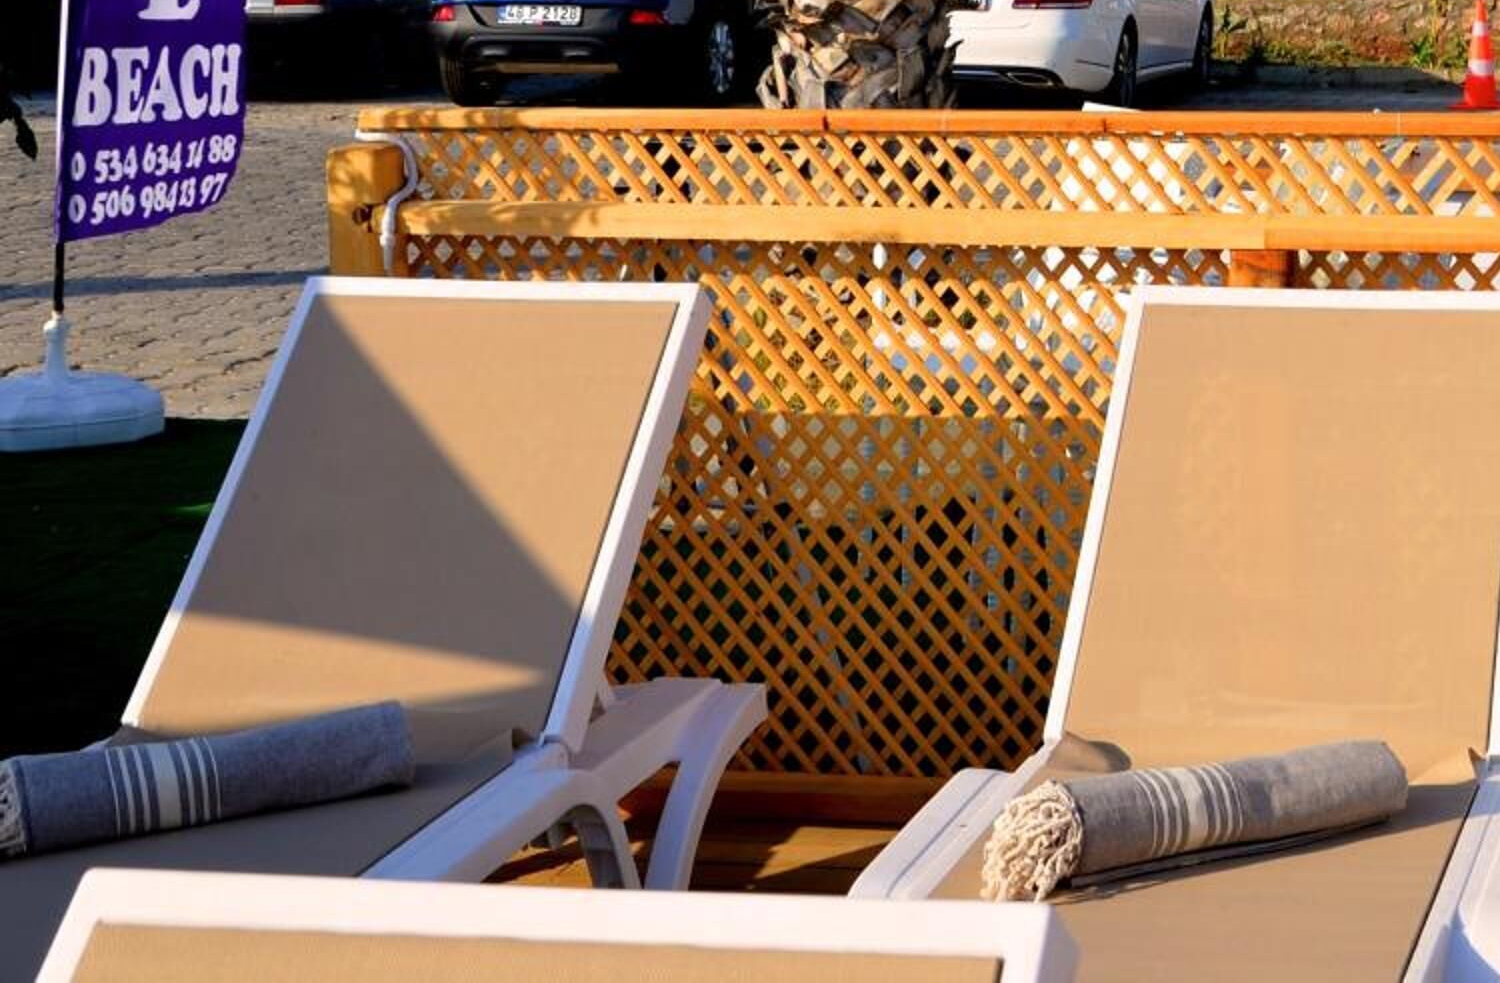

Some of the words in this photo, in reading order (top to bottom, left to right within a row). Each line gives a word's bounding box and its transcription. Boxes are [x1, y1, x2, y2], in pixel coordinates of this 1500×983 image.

[72, 43, 241, 126] BEACH
[70, 150, 87, 182] 0
[93, 144, 139, 184] 534
[142, 139, 183, 177] 634
[207, 134, 237, 165] 88
[67, 194, 87, 224] 0
[90, 185, 136, 225] 506
[200, 172, 229, 205] 97
